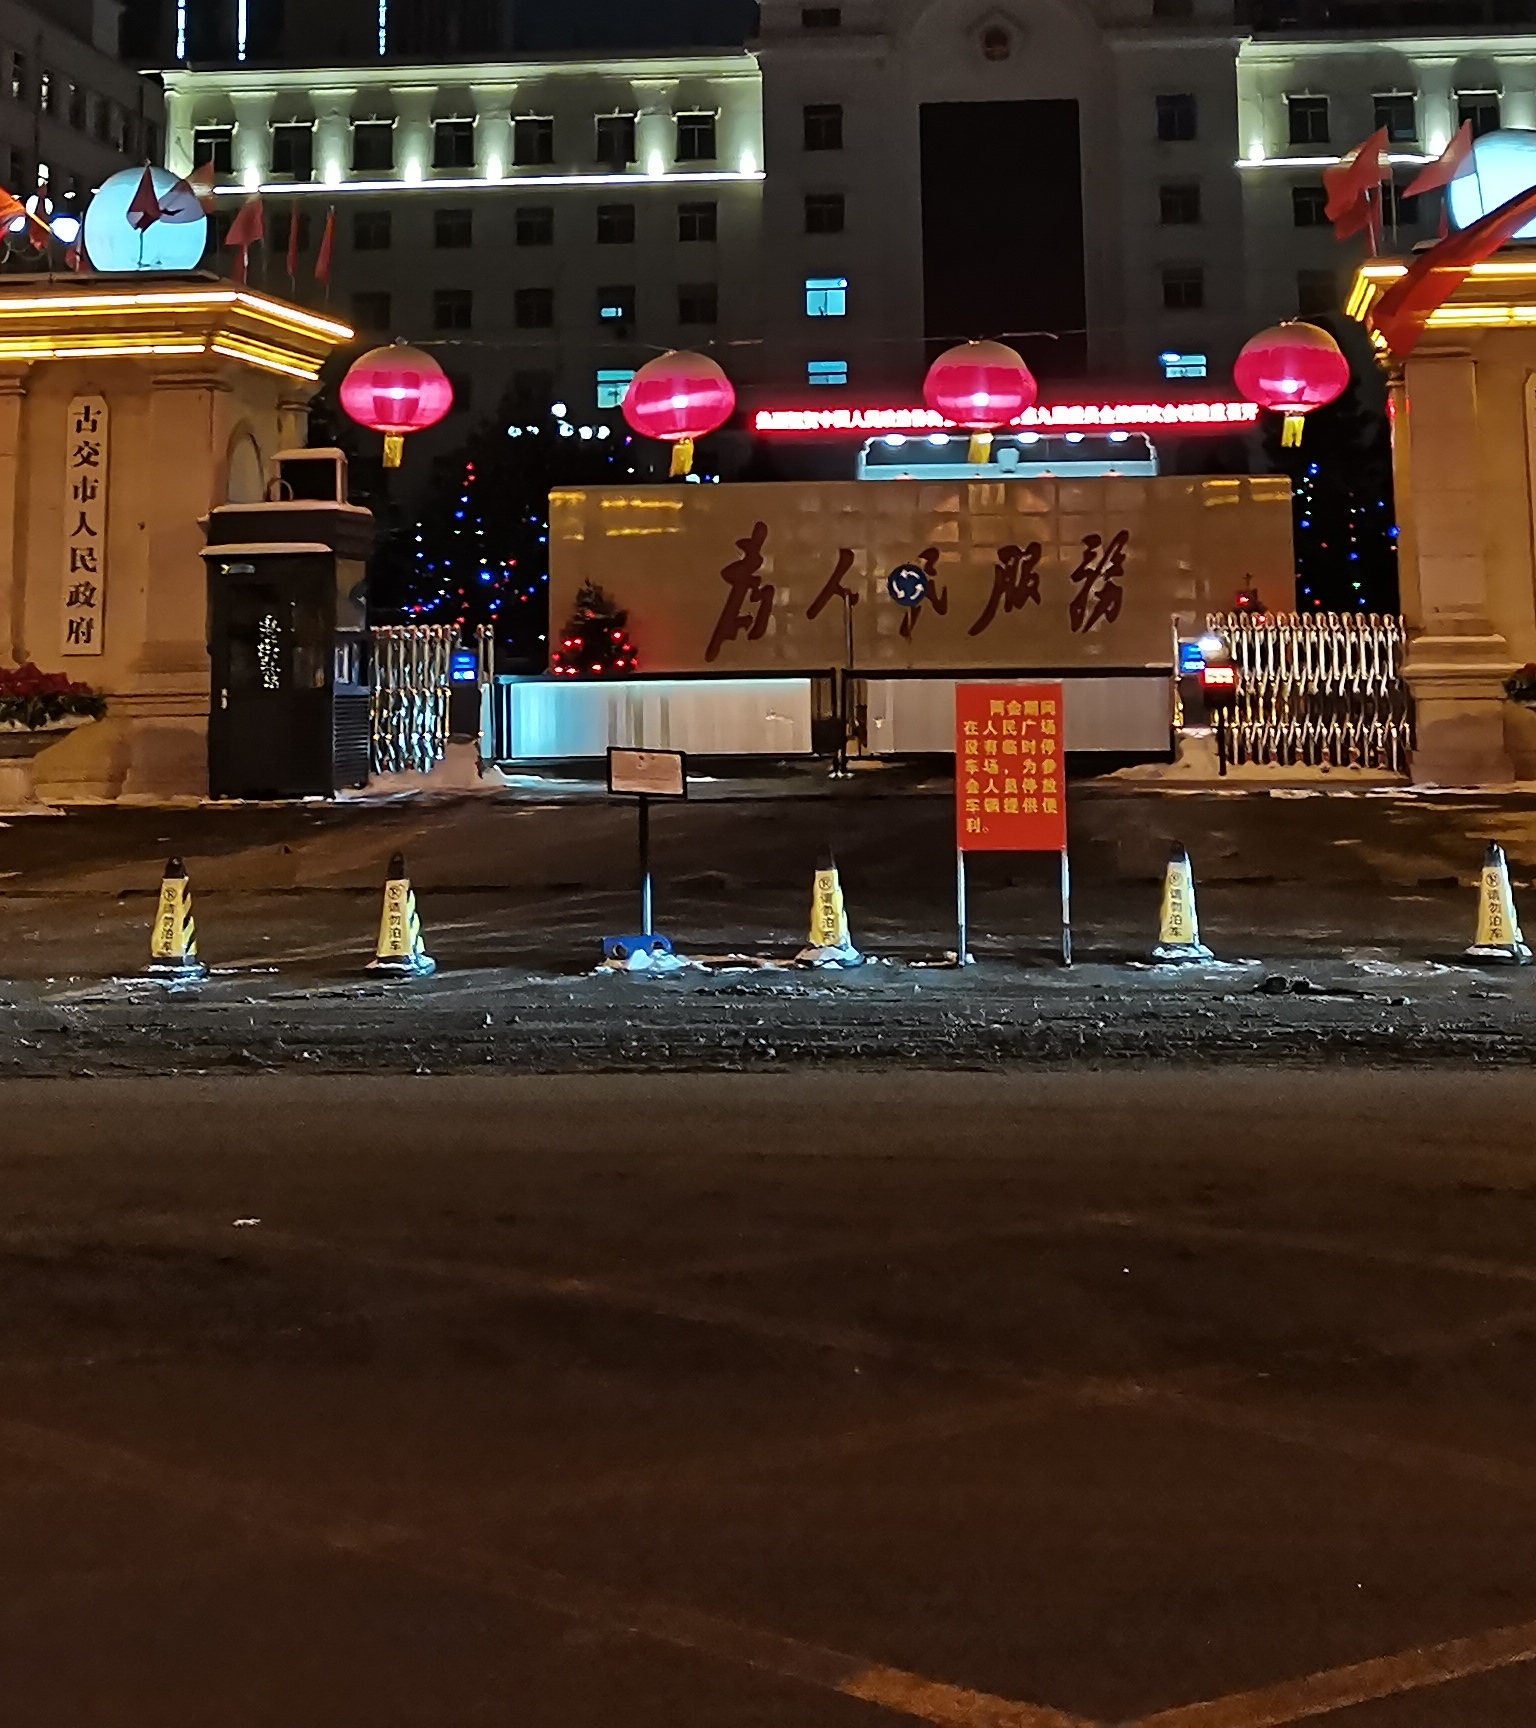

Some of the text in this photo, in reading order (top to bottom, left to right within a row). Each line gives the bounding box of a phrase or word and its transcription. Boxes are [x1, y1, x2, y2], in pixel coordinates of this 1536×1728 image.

[66, 405, 103, 645] 古交市人民政府
[964, 719, 1057, 736] 在人民广场
